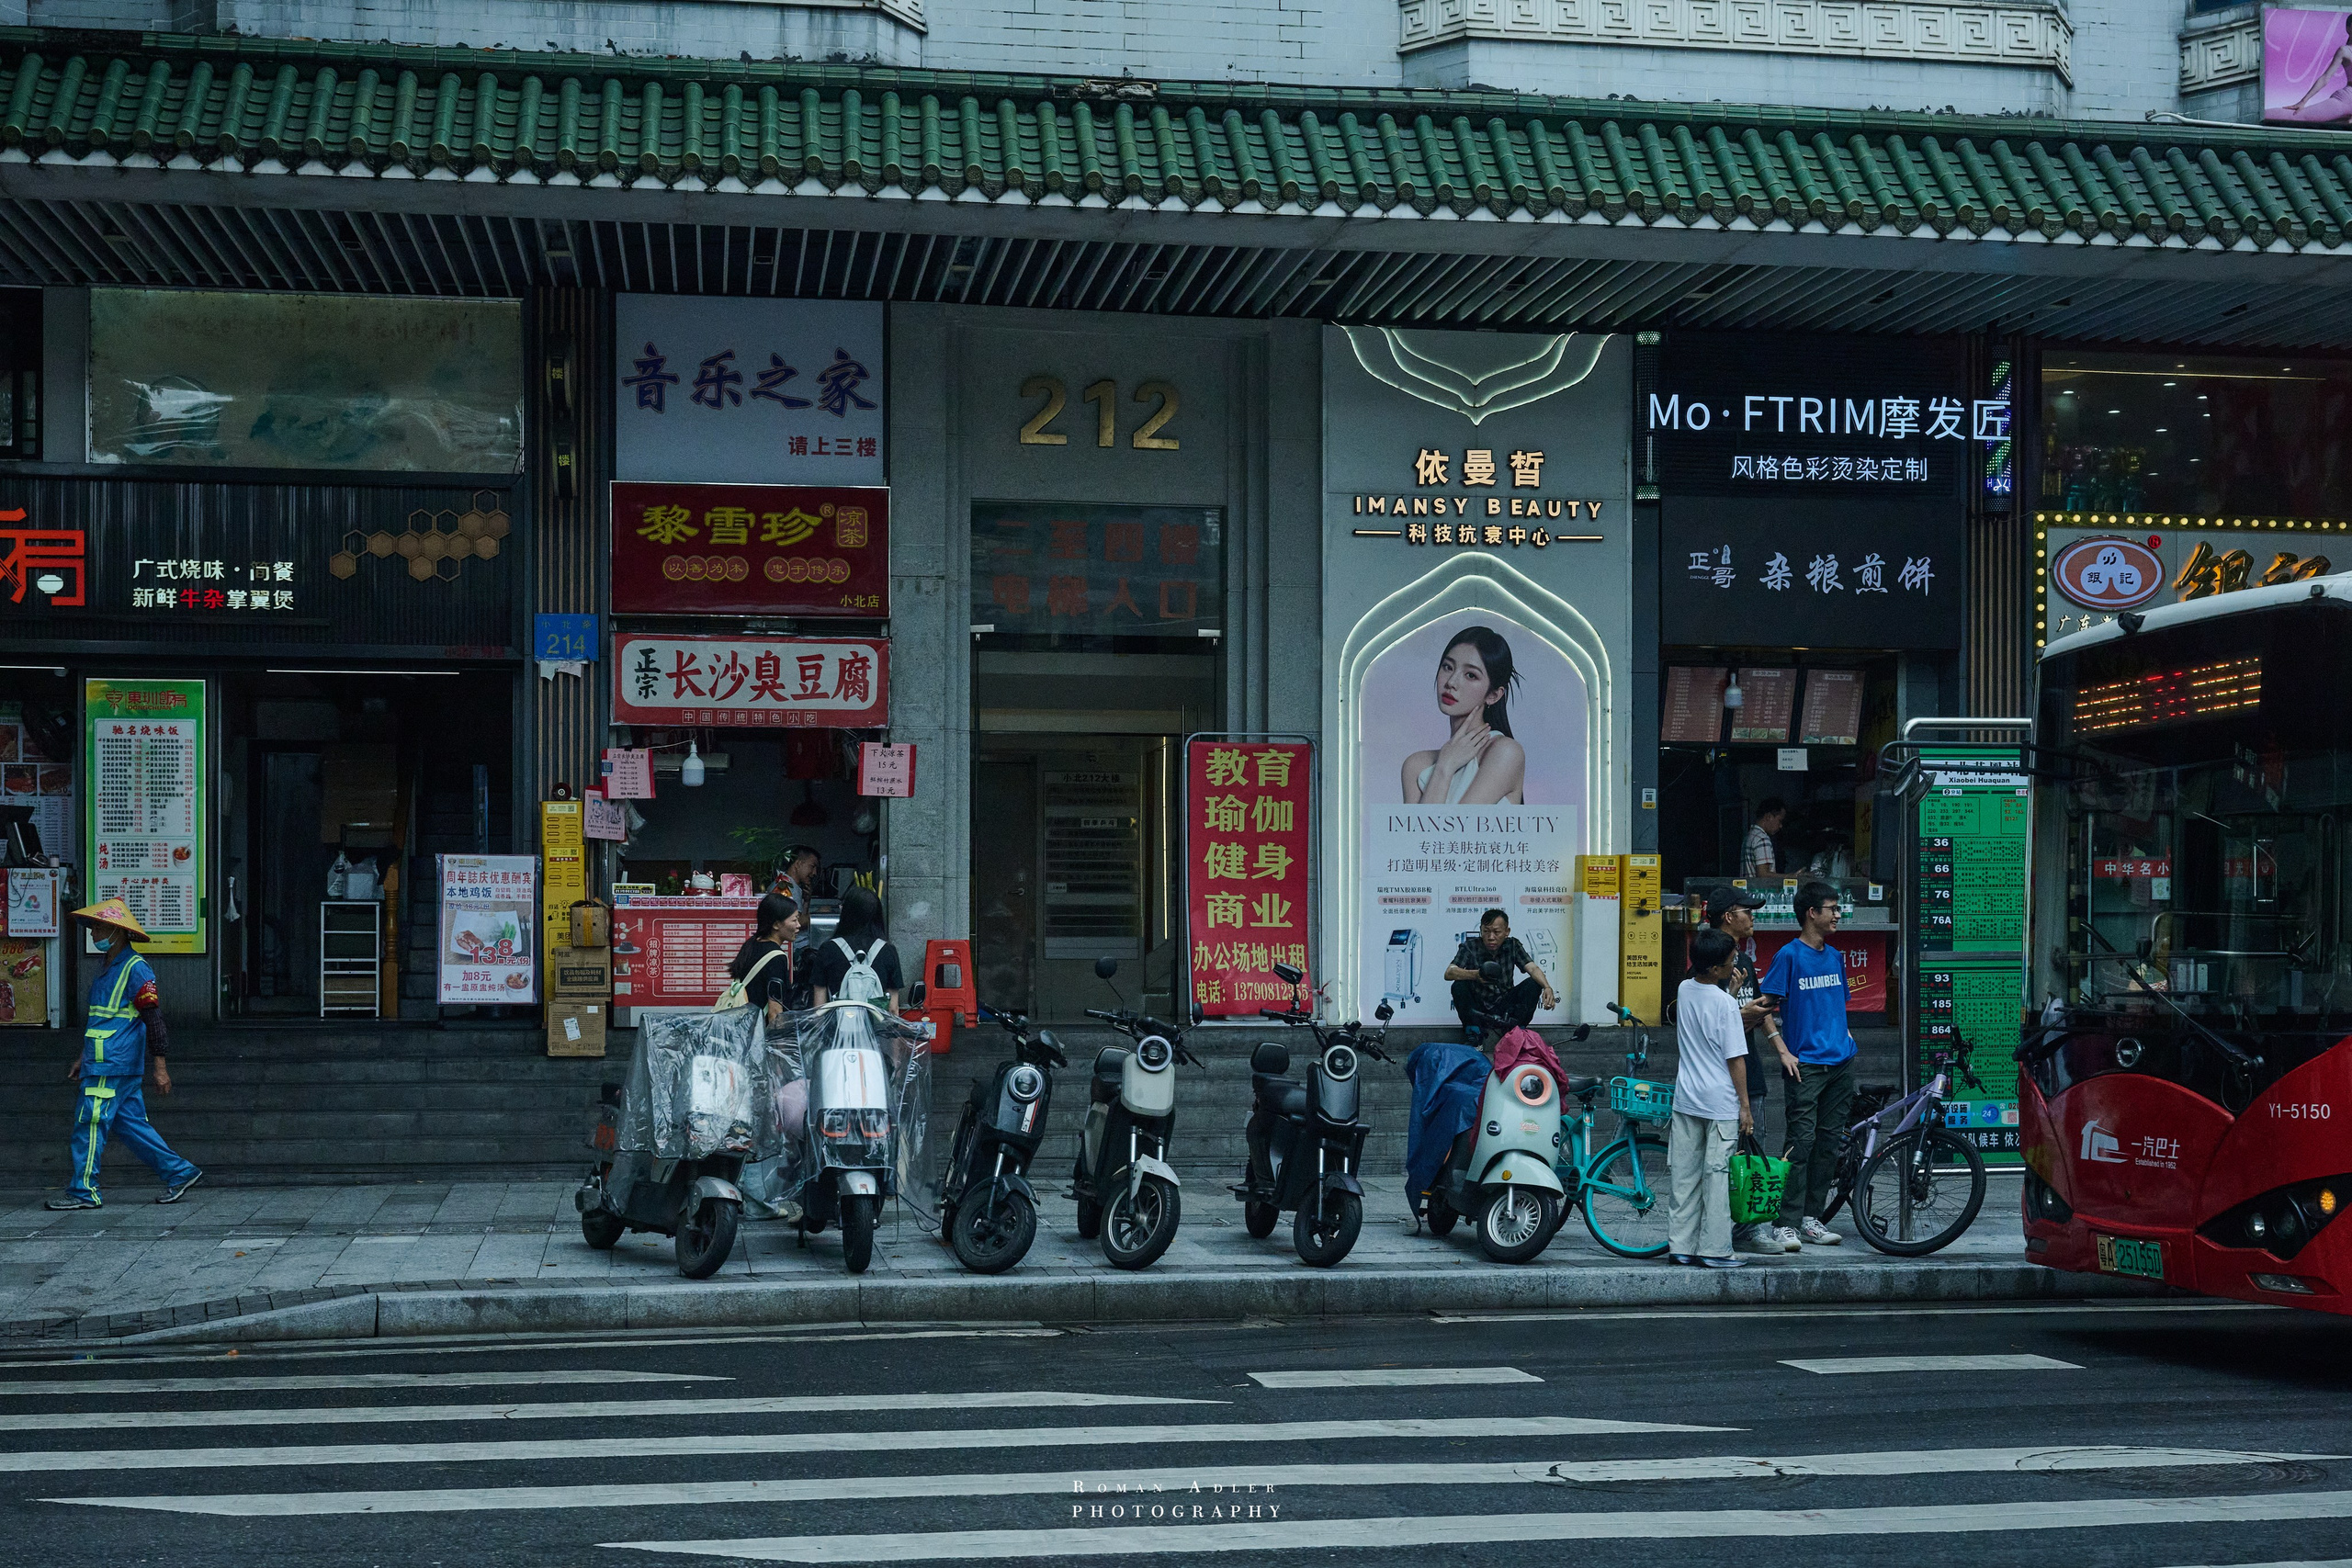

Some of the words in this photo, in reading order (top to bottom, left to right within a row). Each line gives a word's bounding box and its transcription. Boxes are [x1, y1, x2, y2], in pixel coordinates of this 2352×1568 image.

[620, 342, 878, 418] 音乐之家
[1020, 377, 1180, 449] 212
[788, 435, 876, 457] 请上三楼
[1732, 456, 1928, 481] 风格色彩烫染定制
[1355, 497, 1468, 514] IMANSY
[1487, 499, 1602, 518] BEAUTY
[636, 503, 824, 547] 黎雪珍
[840, 510, 865, 546] 凉茶
[1408, 524, 1551, 547] 科技抗衰中心
[669, 563, 744, 573] 以善为本
[770, 564, 845, 576] 忠于传承
[1759, 551, 1935, 596] 杂粮煎饼
[132, 587, 295, 610] 新鲜牛杂掌翼煲
[840, 595, 880, 608] 小北店
[546, 634, 586, 654] 214
[634, 648, 662, 699] 正宗
[664, 649, 873, 703] 长沙臭豆腐
[683, 711, 816, 725] 中国传统特色小吃
[112, 725, 179, 736] 驰名烧味饭
[1204, 748, 1295, 787] 教育
[1204, 794, 1295, 833] 瑜伽
[1388, 816, 1469, 833] IMANSY
[1476, 816, 1558, 833] BAEUTY
[1419, 841, 1529, 854] 专注美肤抗衰九年
[1933, 838, 1949, 847] 36
[1203, 842, 1294, 881] 健身
[1387, 859, 1560, 873] 打造明星级·定制化科技美容
[1934, 864, 1950, 873] 66
[2104, 863, 2169, 875] 中华名小
[447, 886, 492, 898] 本地鸡饭
[1934, 890, 1950, 898] 76
[1204, 891, 1294, 929] 商业
[1932, 916, 1951, 924] 76A
[469, 939, 514, 964] 13.8
[650, 940, 658, 976] 招牌凉茶
[1193, 941, 1307, 973] 办公场地出租
[462, 971, 492, 982] 加8元
[1934, 974, 1950, 982] 93
[1932, 999, 1951, 1008] 185
[1931, 1025, 1951, 1034] 864
[2269, 1104, 2331, 1120] Y1-5150
[2131, 1135, 2180, 1159] 一汽巴士
[2160, 1160, 2165, 1168] in
